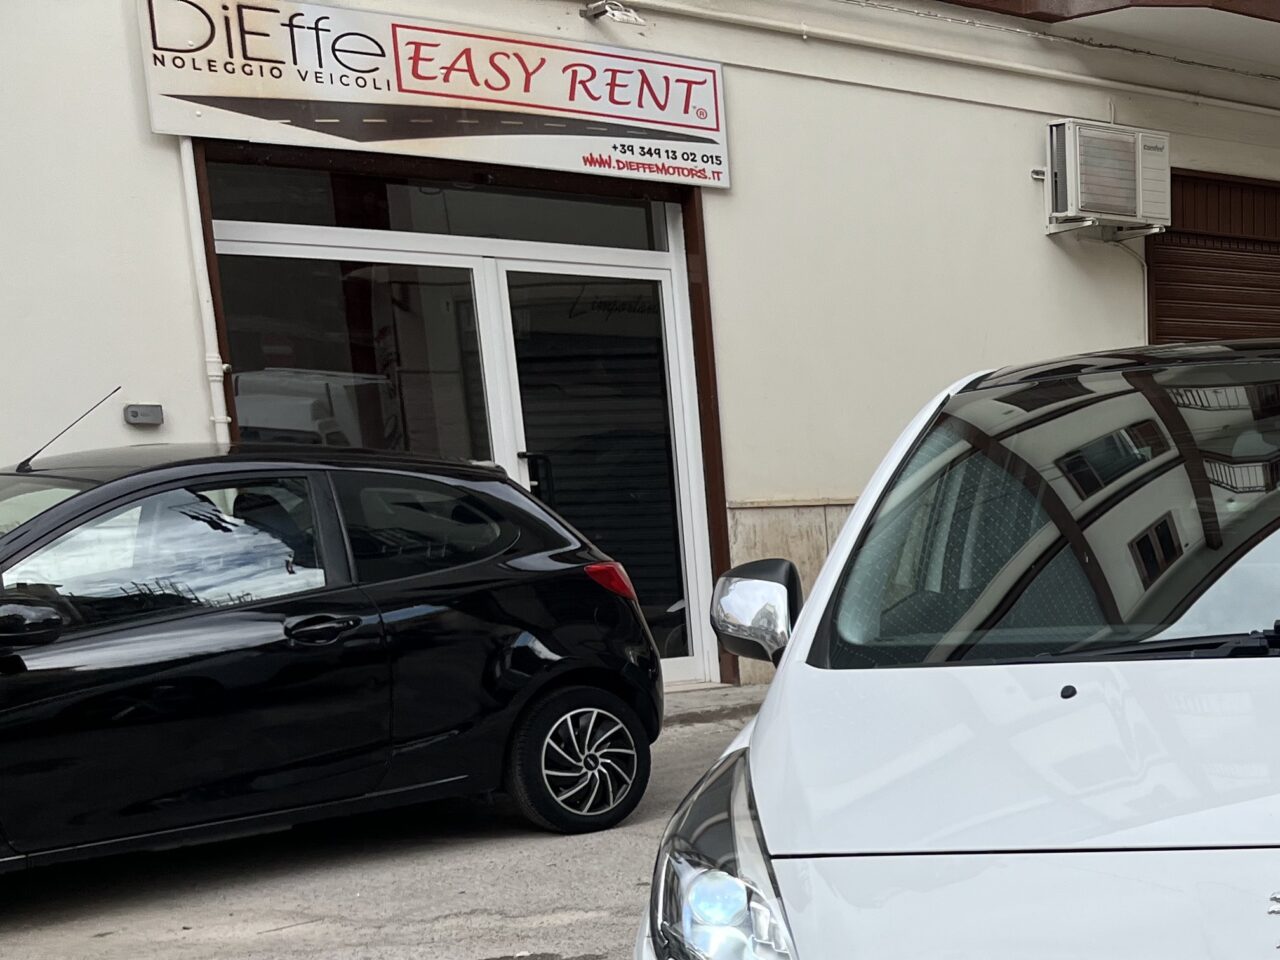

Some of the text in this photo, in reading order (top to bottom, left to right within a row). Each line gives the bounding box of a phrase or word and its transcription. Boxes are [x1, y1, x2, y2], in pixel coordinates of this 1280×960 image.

[147, 0, 386, 73] DiEffe
[152, 53, 391, 91] NOLEGGIO VEICOLI
[404, 41, 707, 115] EASY RENT
[611, 143, 722, 165] +39 349 13 02 015
